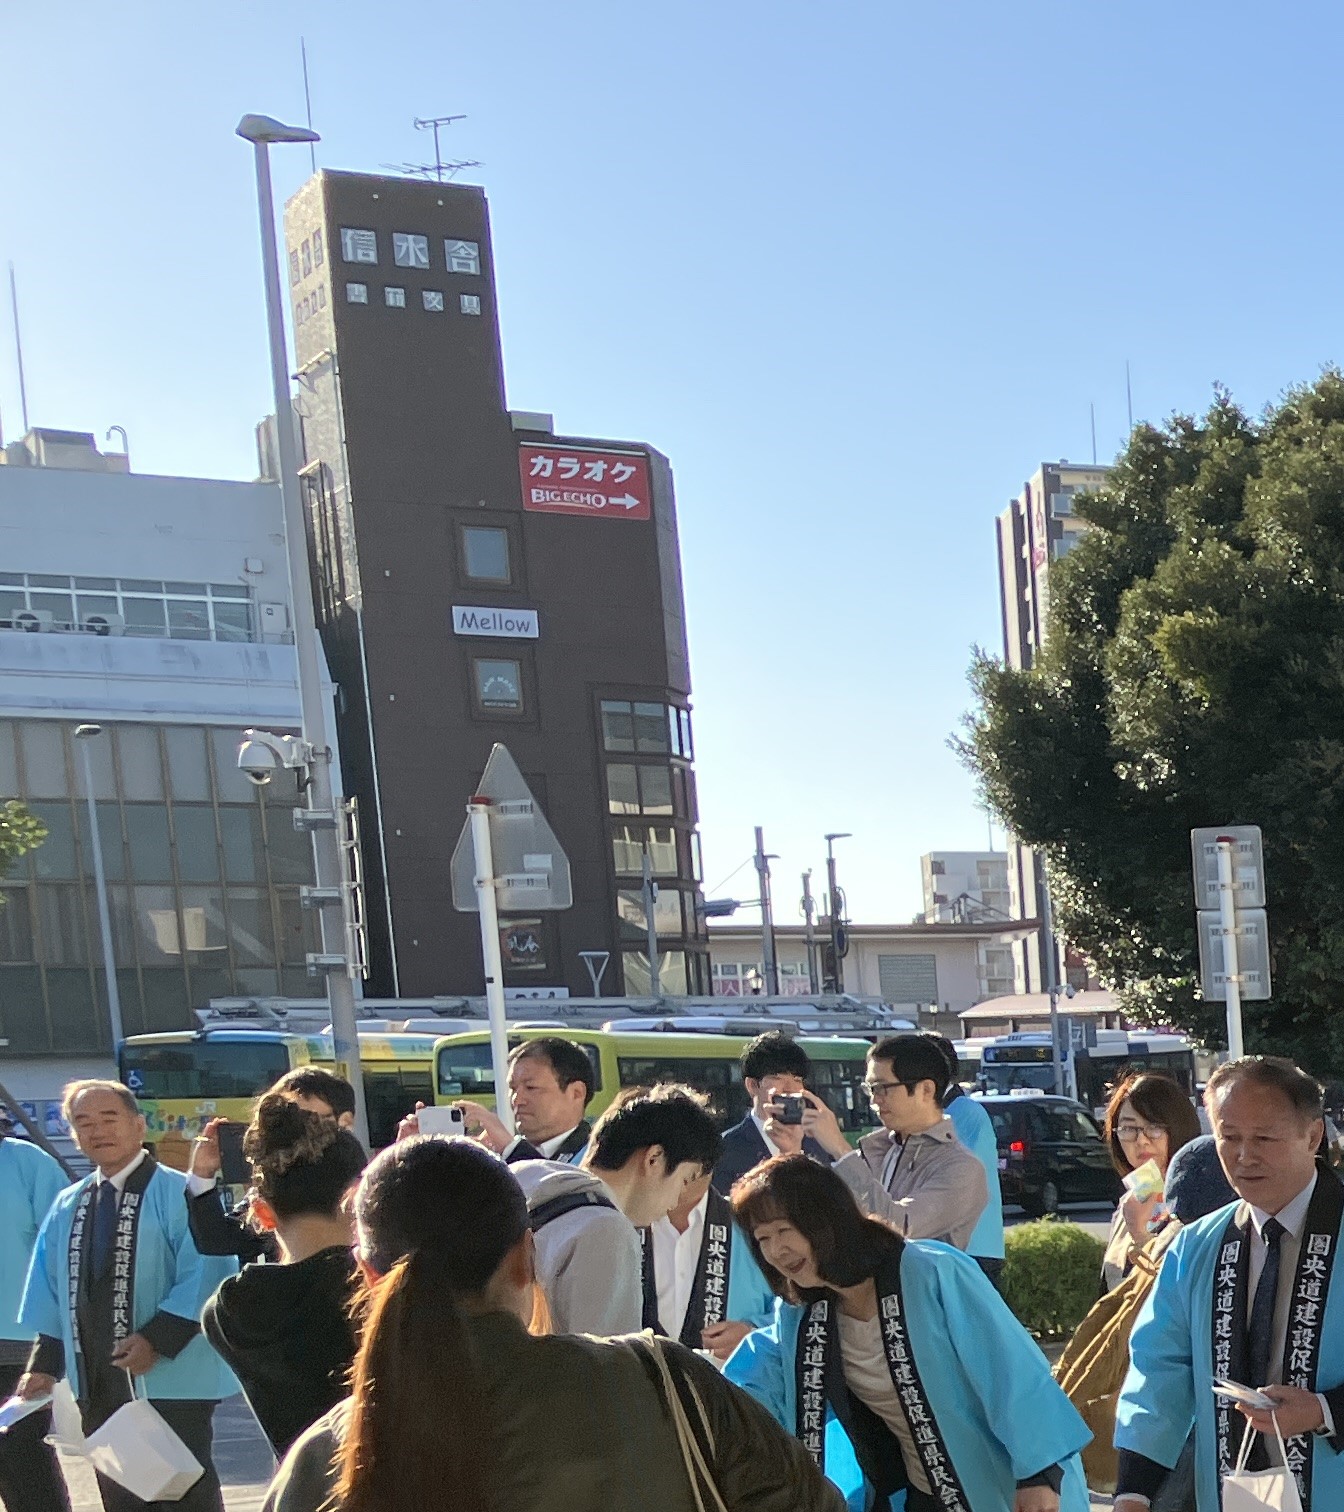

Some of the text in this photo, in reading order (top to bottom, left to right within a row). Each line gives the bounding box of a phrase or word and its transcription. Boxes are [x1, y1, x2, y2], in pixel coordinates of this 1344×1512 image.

[530, 456, 636, 482] カラオケ
[531, 489, 607, 508] BIG ECHO
[460, 612, 531, 633] Mellow
[195, 1101, 217, 1113] JR
